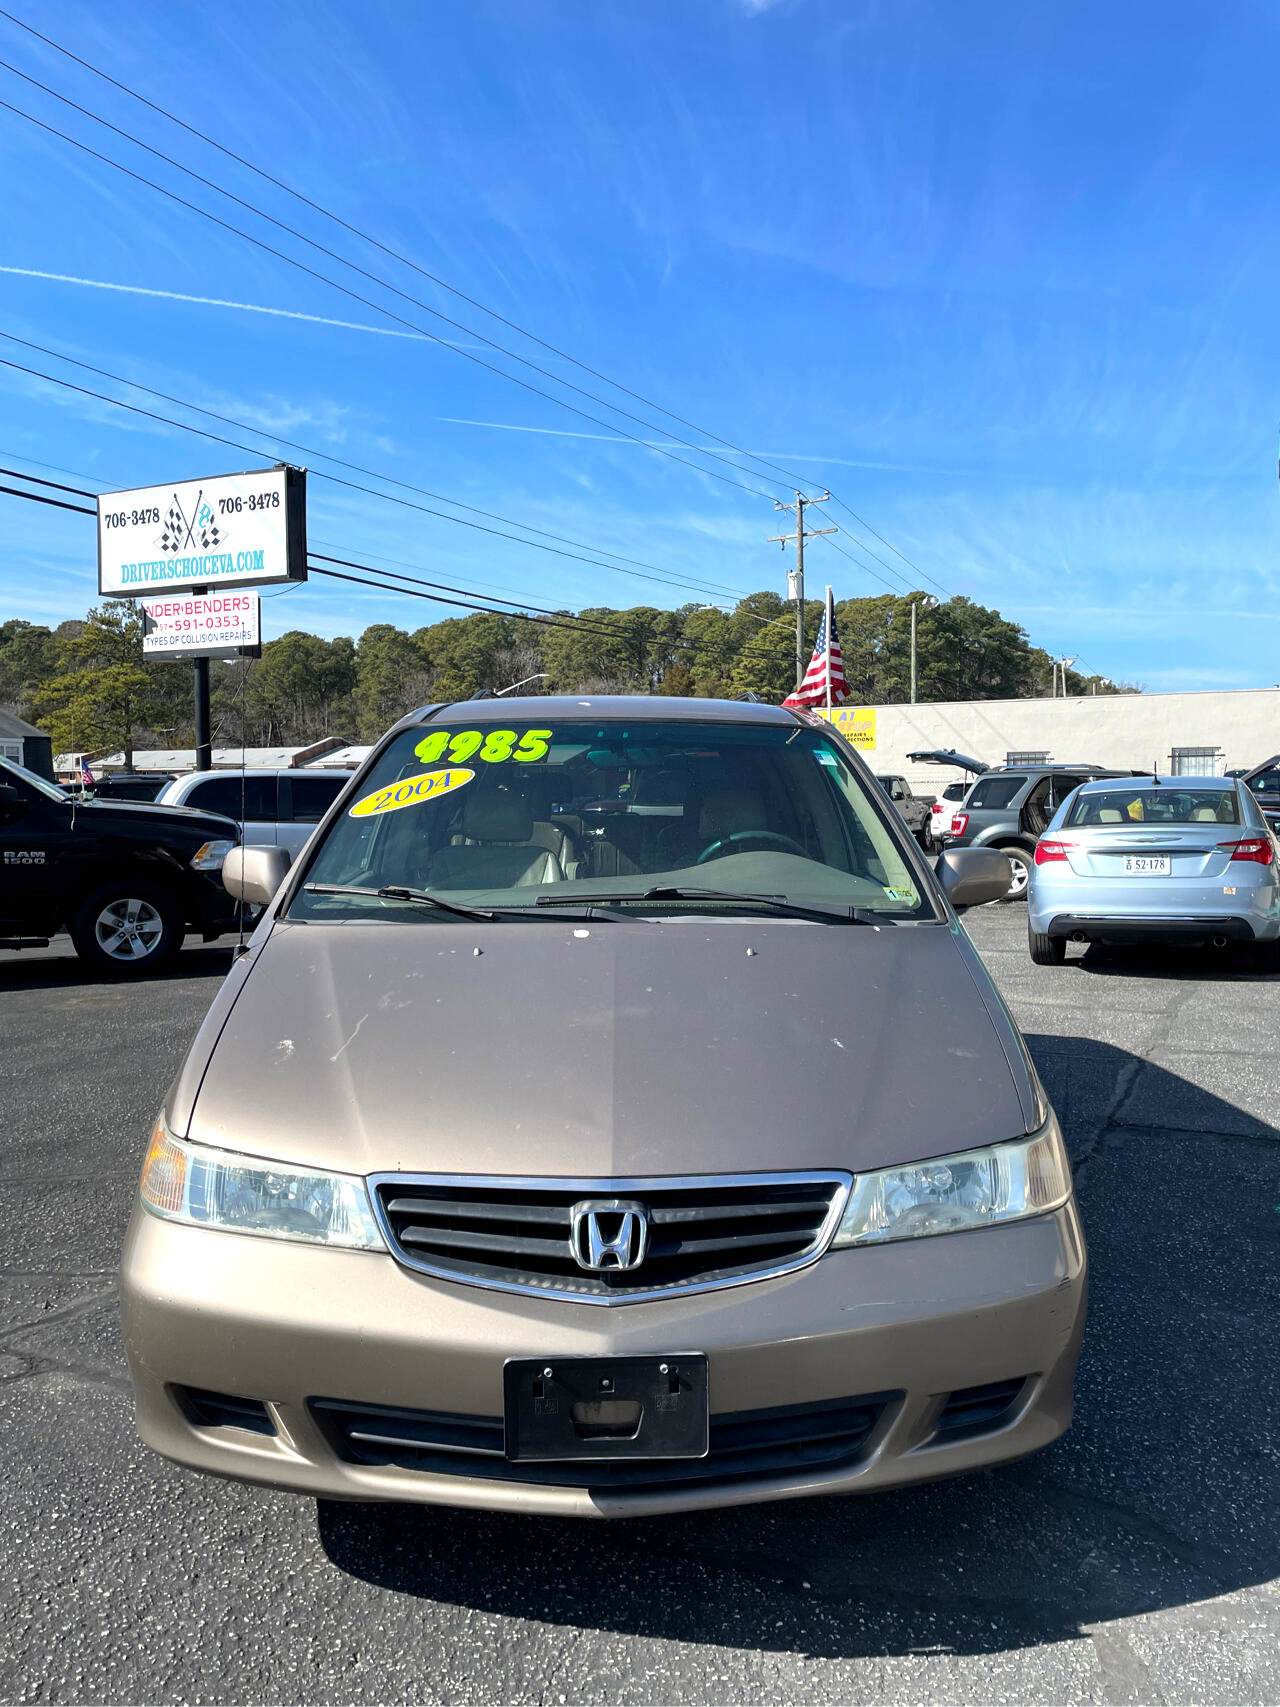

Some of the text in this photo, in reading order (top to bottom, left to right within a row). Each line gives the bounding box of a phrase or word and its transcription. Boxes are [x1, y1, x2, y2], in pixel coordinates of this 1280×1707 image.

[218, 491, 280, 515] 706-3478
[104, 507, 160, 529] 706-3478
[121, 549, 265, 584] DRIVERSCHOICEVA.COM
[146, 630, 252, 647] TYPES OF COLLISION REPAIRS
[414, 729, 553, 764] 4985
[373, 772, 453, 811] 2004
